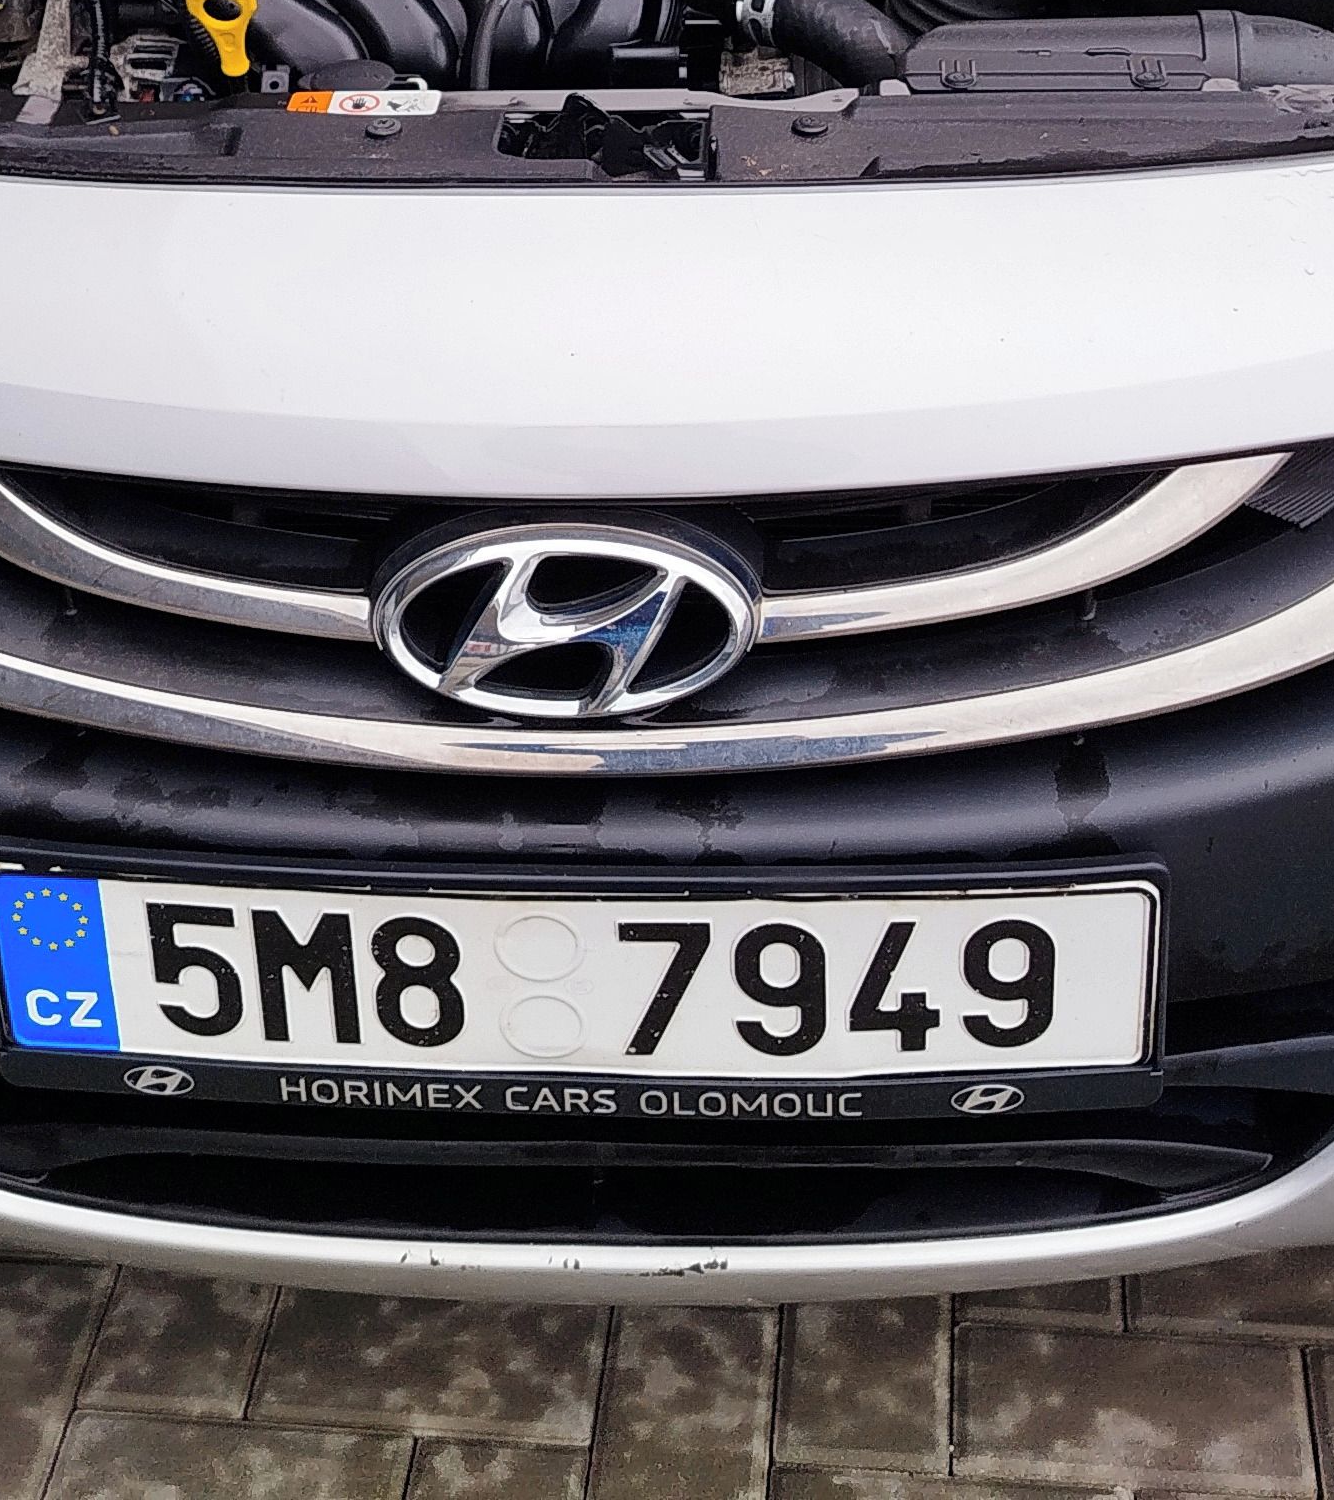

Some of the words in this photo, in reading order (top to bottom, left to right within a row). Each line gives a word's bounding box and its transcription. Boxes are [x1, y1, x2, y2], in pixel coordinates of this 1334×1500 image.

[145, 901, 466, 1048] 5M8
[617, 919, 1057, 1057] 7949
[25, 988, 103, 1028] CZ
[279, 1077, 483, 1111] HORIMEX
[504, 1086, 618, 1113] CARS
[639, 1091, 863, 1118] OLOMOUC
